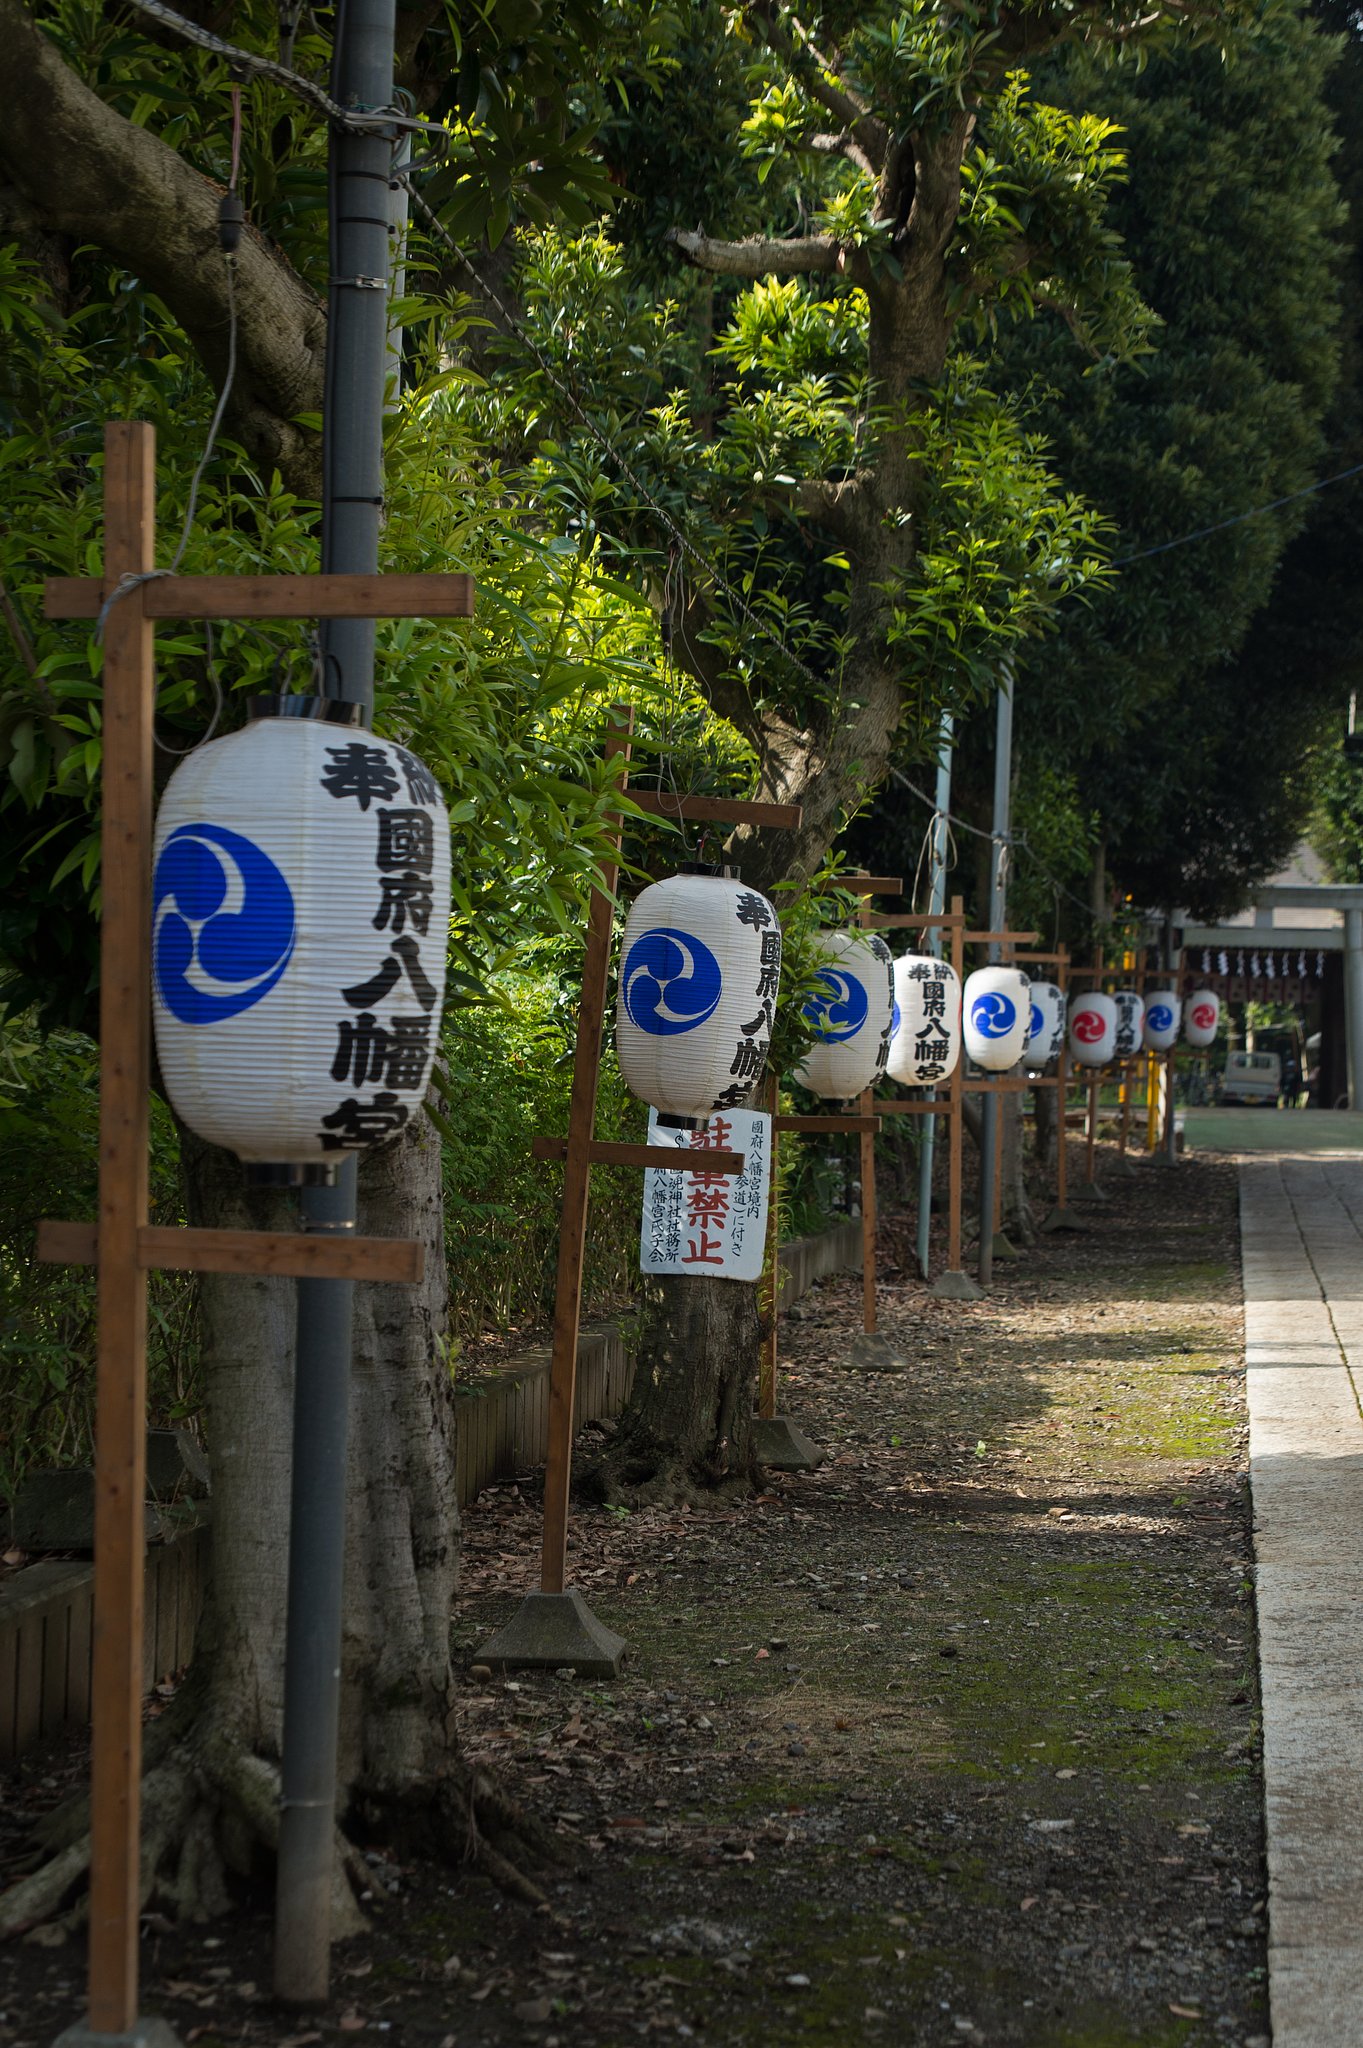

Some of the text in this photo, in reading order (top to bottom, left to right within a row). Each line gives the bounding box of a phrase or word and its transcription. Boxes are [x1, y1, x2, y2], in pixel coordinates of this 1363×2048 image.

[316, 807, 438, 1152] 國府八幡宮
[914, 981, 951, 1081] 國府八幡宮
